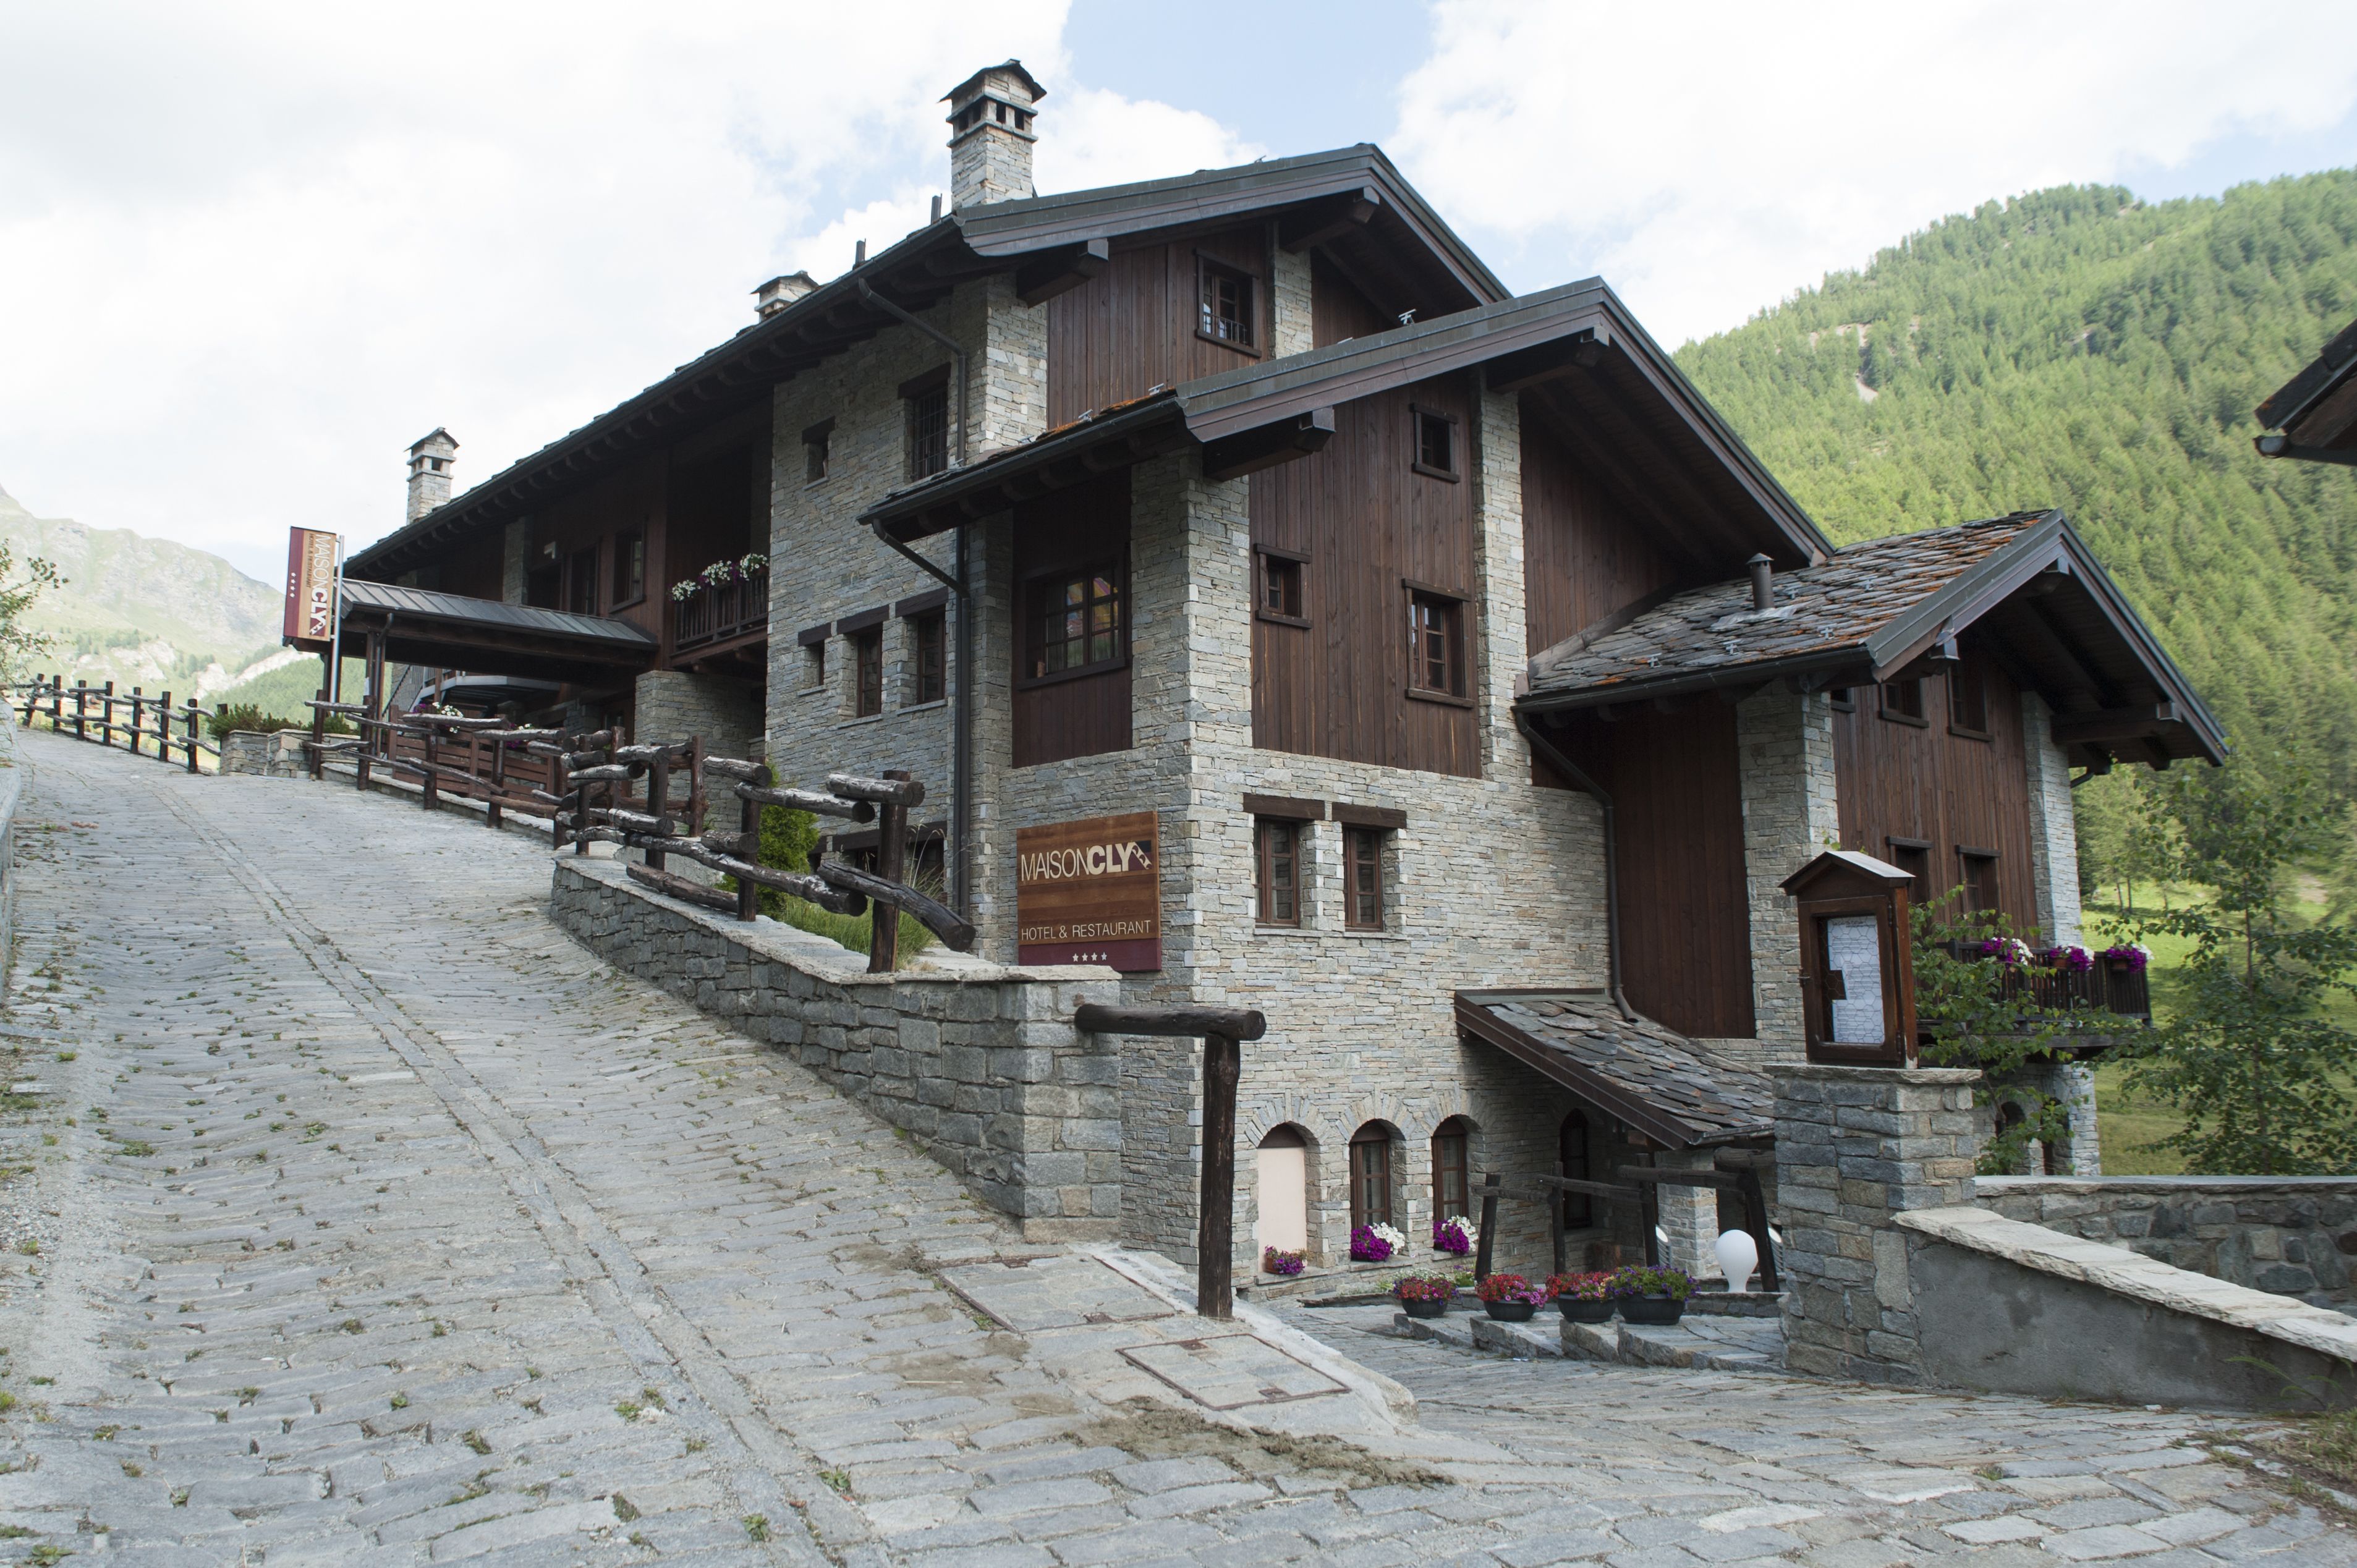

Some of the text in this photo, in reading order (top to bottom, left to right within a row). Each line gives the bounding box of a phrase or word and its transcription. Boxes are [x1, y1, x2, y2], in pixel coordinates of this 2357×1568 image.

[1021, 920, 1152, 941] HOTEL & RESTAURANT
